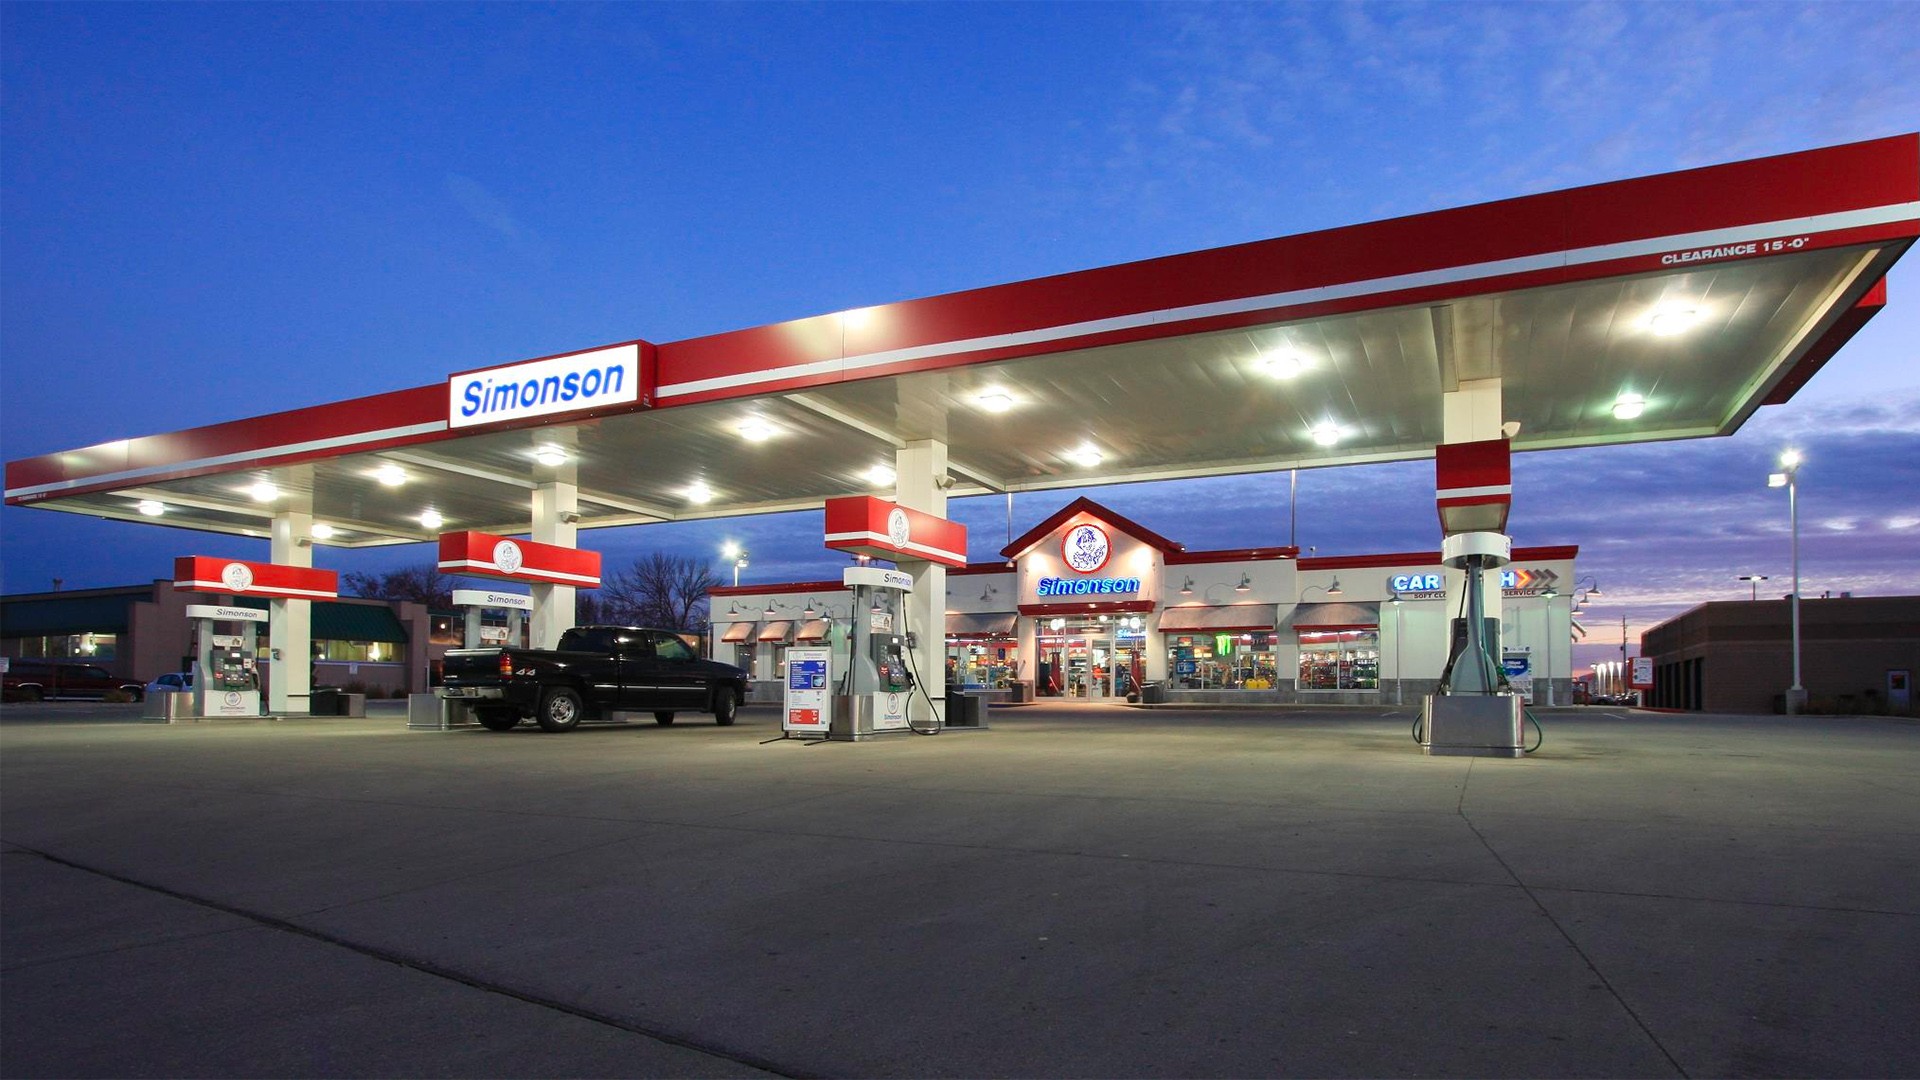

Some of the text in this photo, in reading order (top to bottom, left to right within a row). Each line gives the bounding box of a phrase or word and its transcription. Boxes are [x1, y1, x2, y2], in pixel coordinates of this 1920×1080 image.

[1661, 243, 1756, 265] CLEARANCE
[461, 364, 625, 417] Simonson
[1036, 576, 1141, 596] Simonson
[1393, 574, 1440, 590] CAR
[487, 594, 526, 606] Simonson
[216, 608, 258, 618] Simonson
